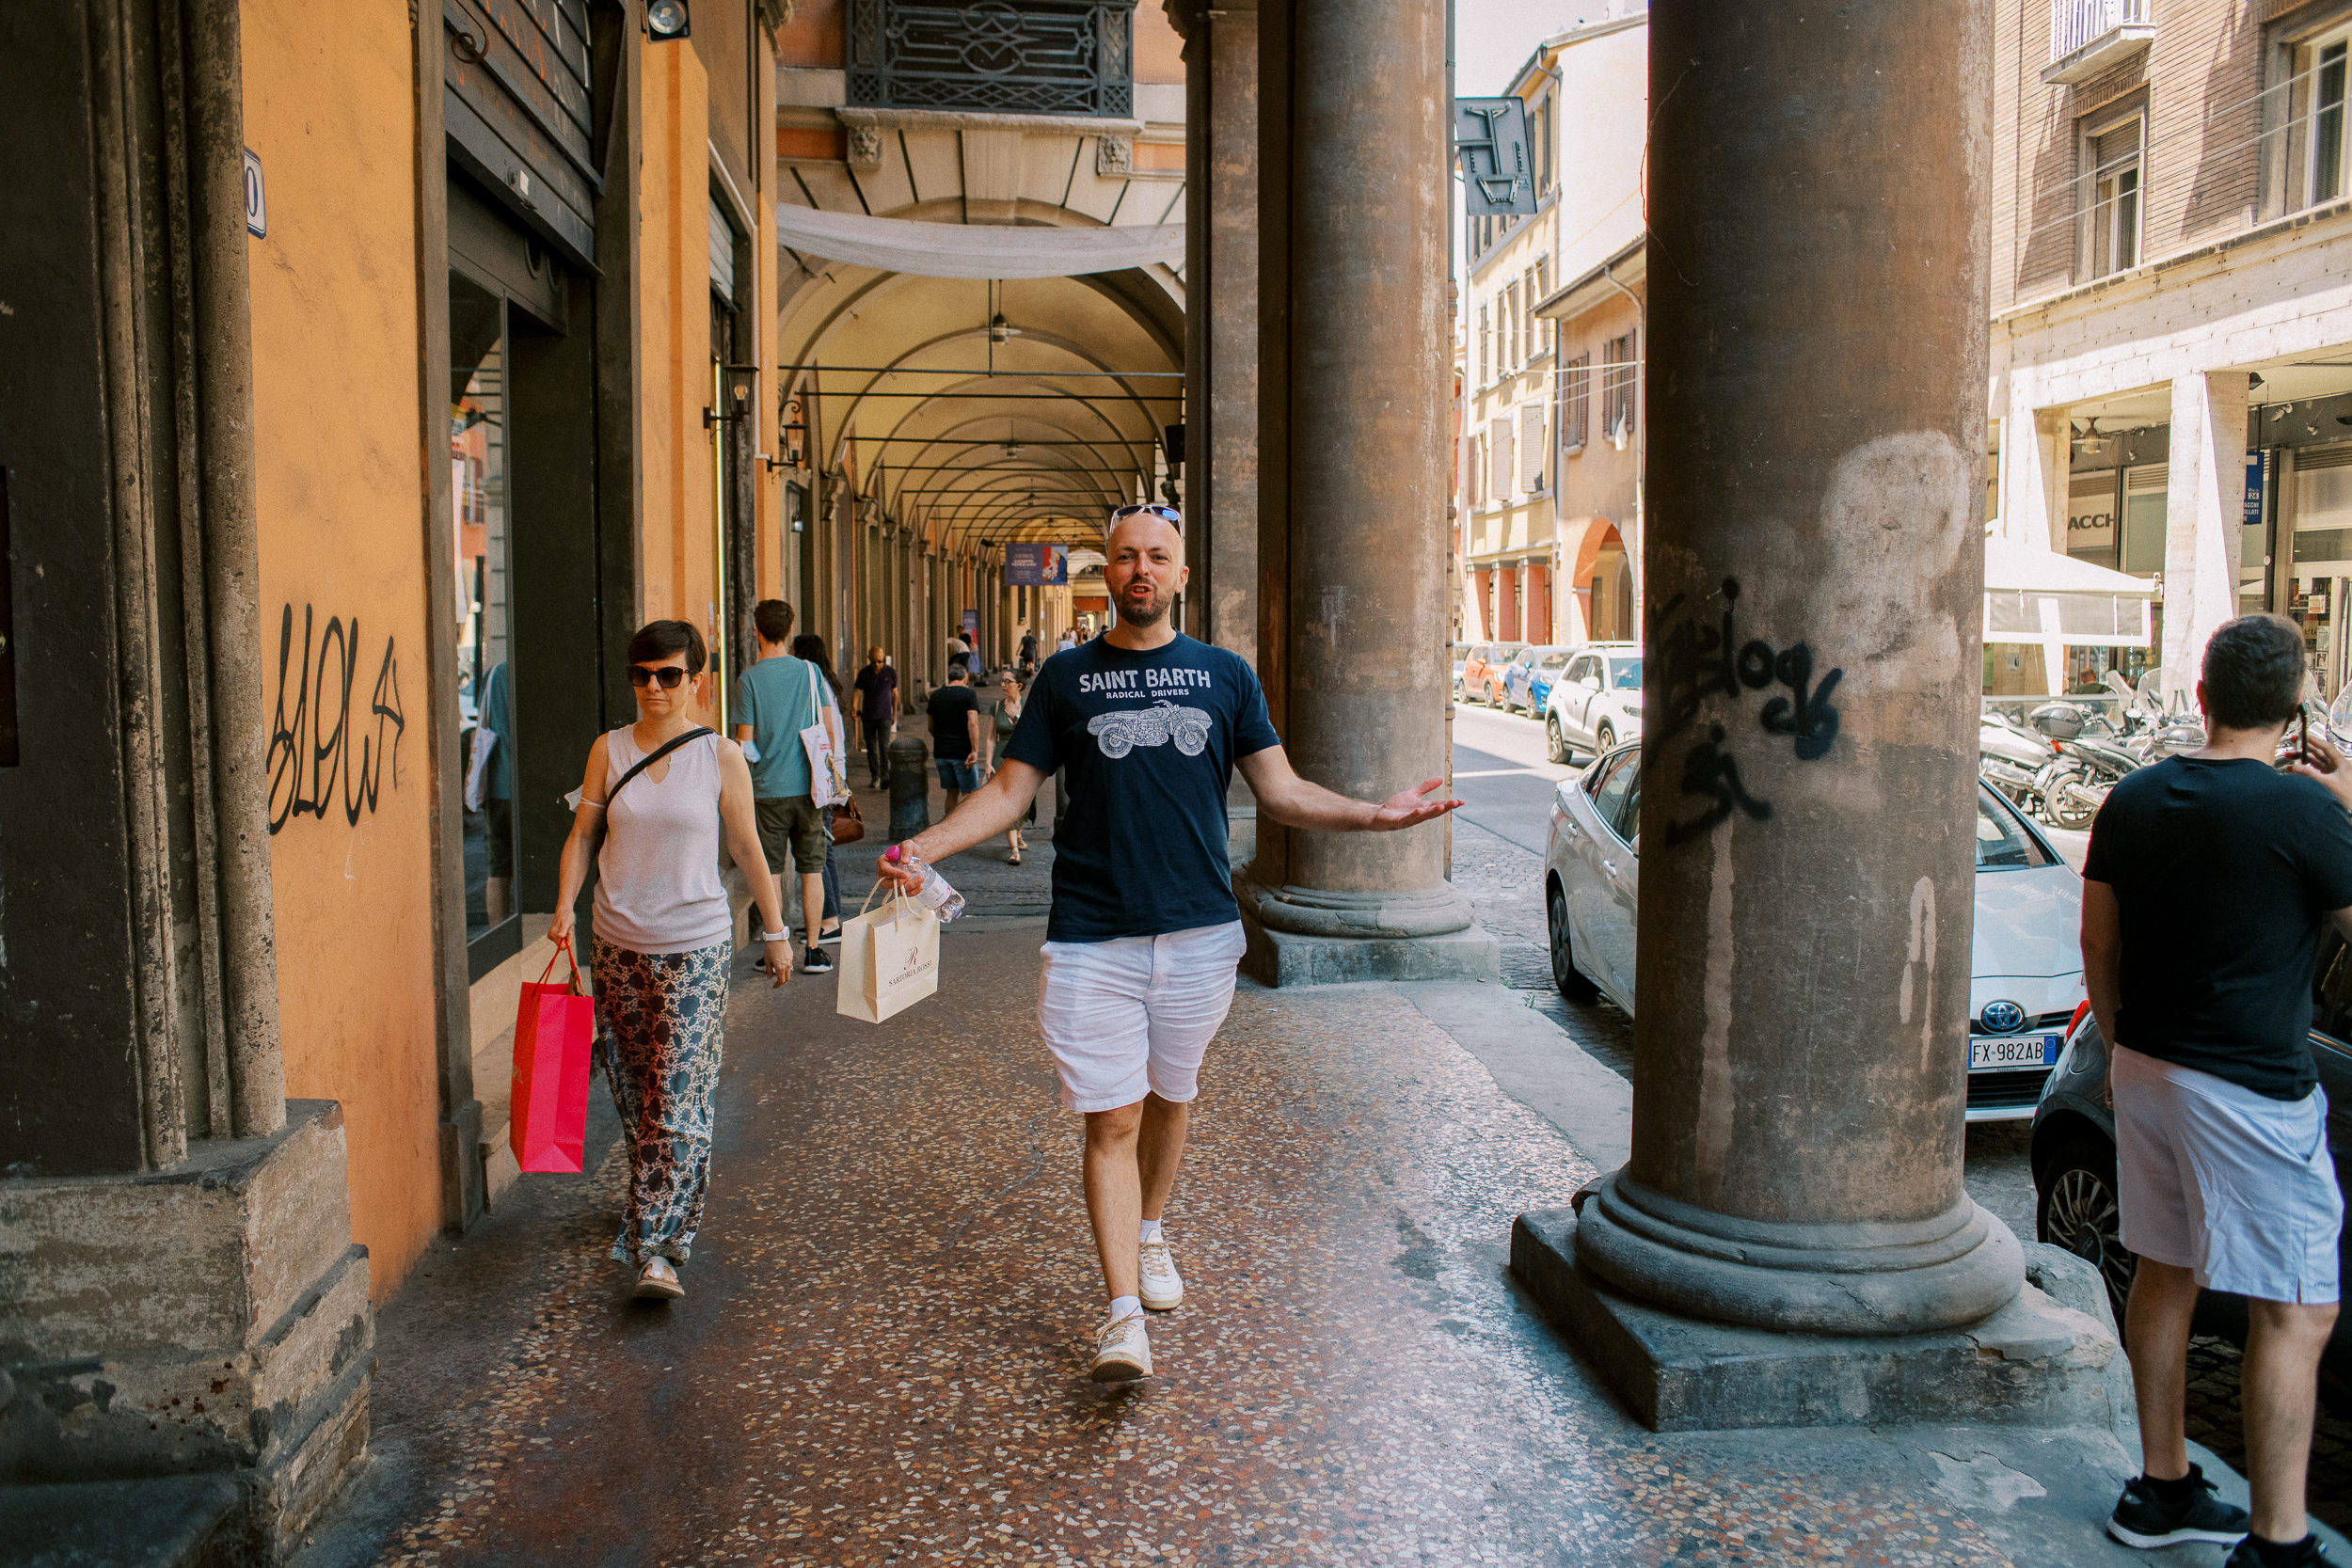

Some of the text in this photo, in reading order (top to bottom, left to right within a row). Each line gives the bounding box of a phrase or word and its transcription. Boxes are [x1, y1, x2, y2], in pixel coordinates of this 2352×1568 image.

[1079, 668, 1211, 692] SAINT BARTH
[1106, 689, 1189, 699] RADICAL DRIVERS
[888, 959, 933, 986] SARTORIA ROSSI
[1973, 1041, 2043, 1062] FX 982AB
